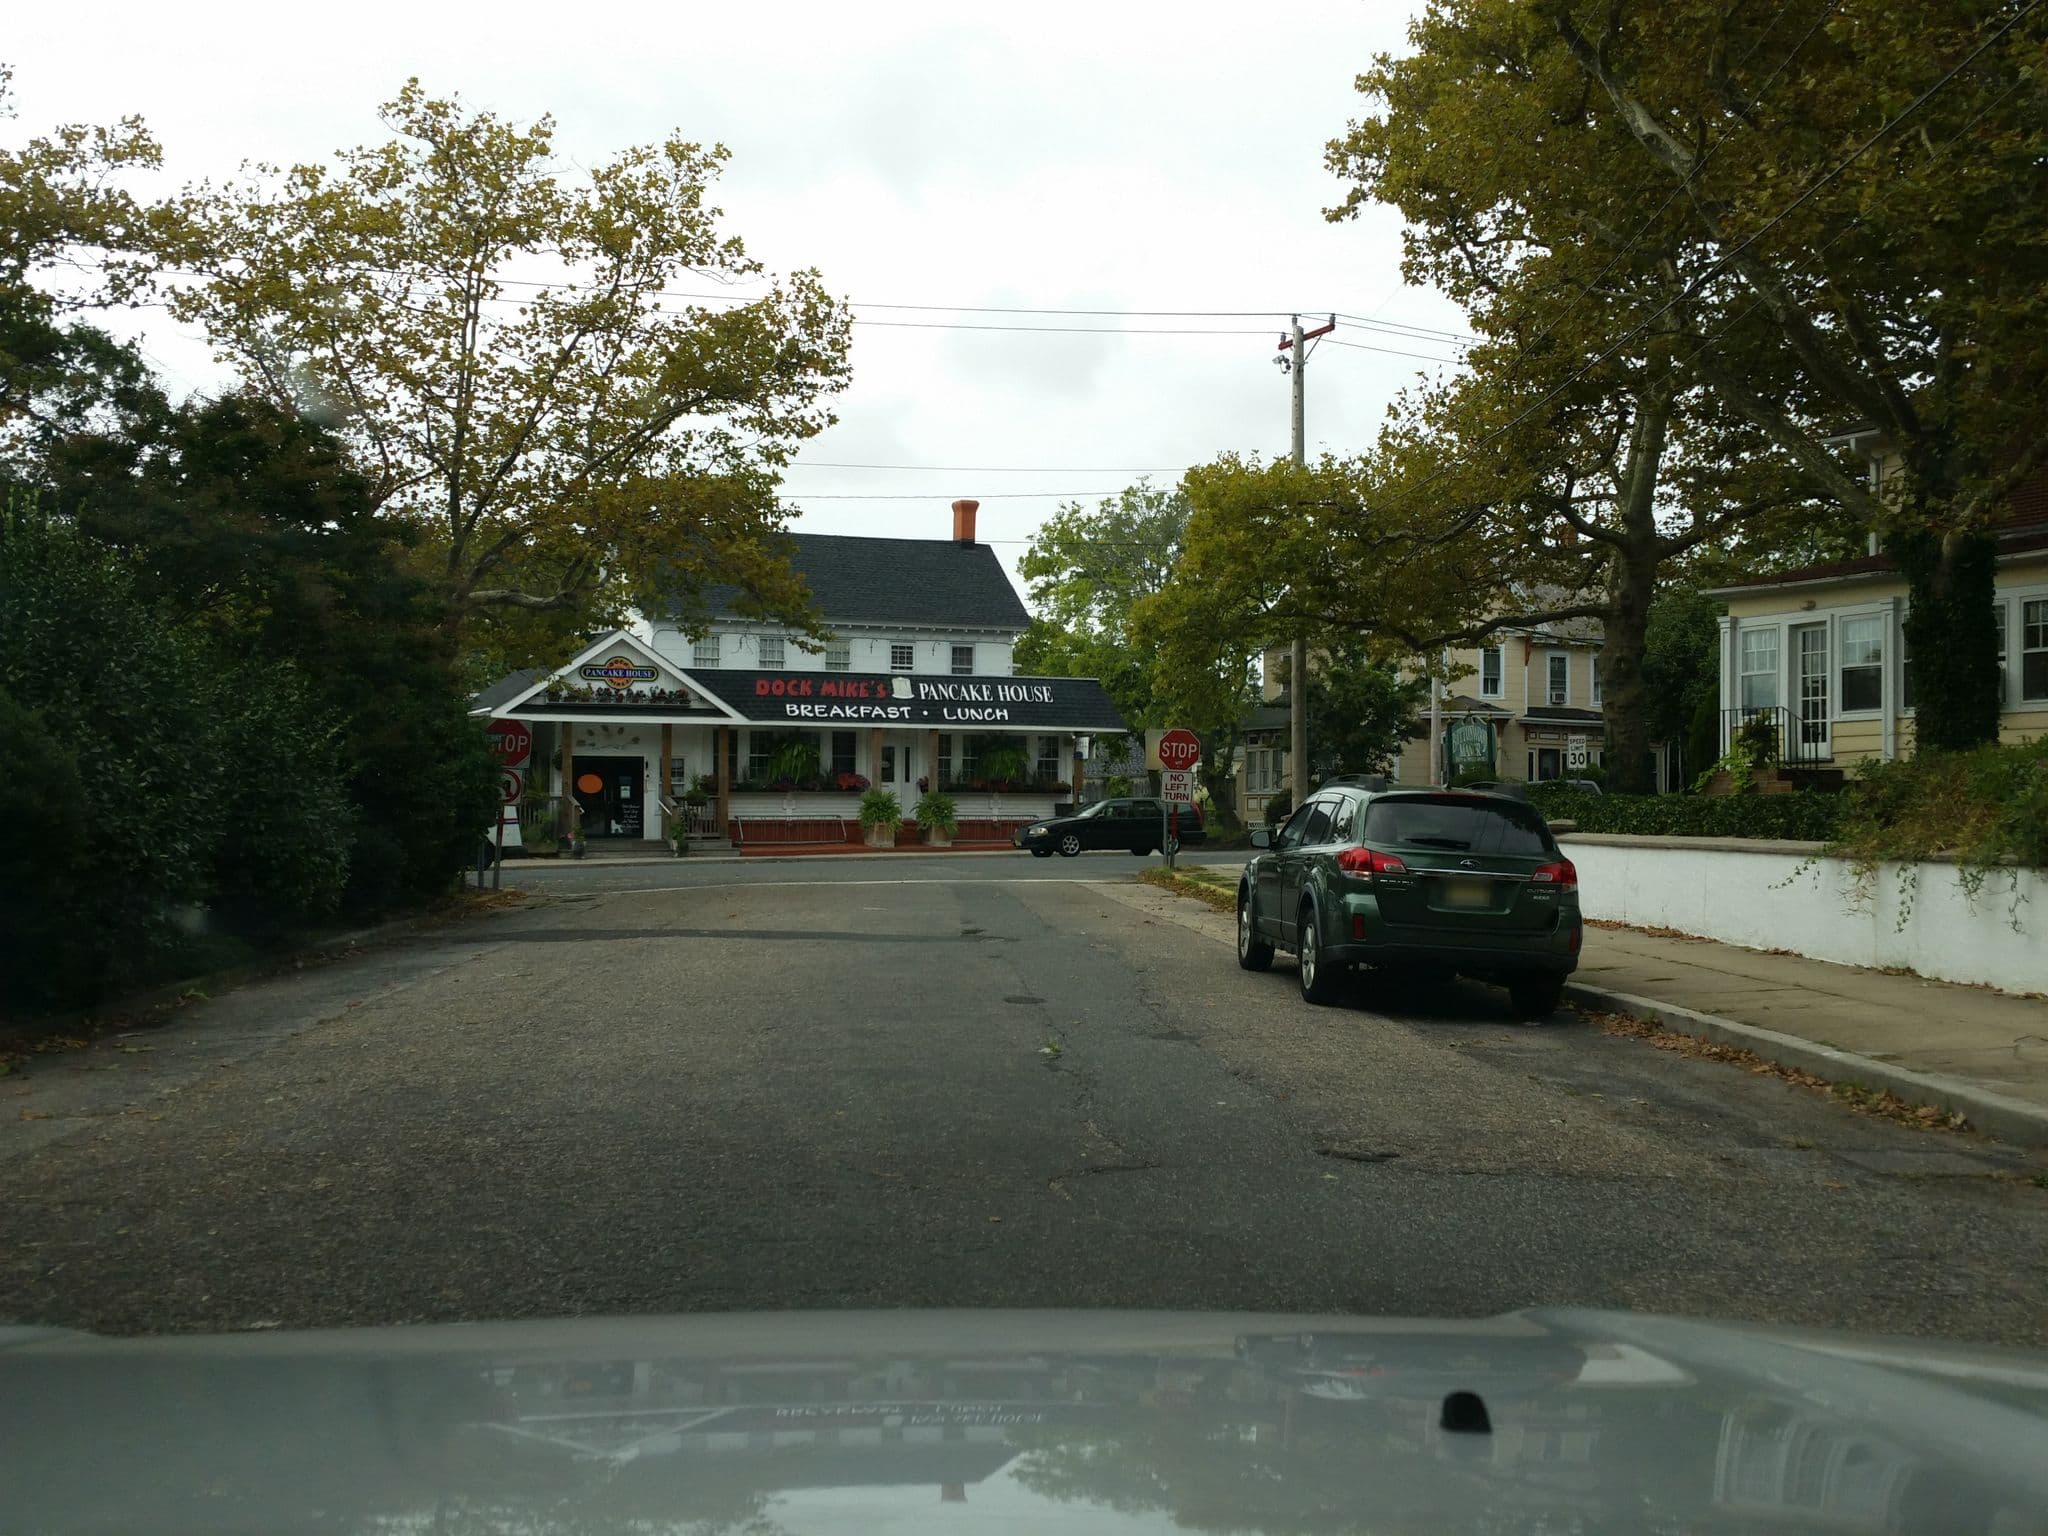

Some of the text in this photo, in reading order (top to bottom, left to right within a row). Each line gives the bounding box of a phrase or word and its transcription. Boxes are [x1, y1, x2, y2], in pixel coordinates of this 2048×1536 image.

[755, 679, 1054, 703] DOCK MIKE'S PANCAKE HOUSE
[786, 704, 1009, 720] BREAKFAST LUNCH
[1161, 742, 1197, 759] STOP
[1570, 753, 1585, 765] 30
[1170, 774, 1184, 782] NO
[1165, 783, 1188, 791] LEFT
[1164, 792, 1189, 801] TURN
